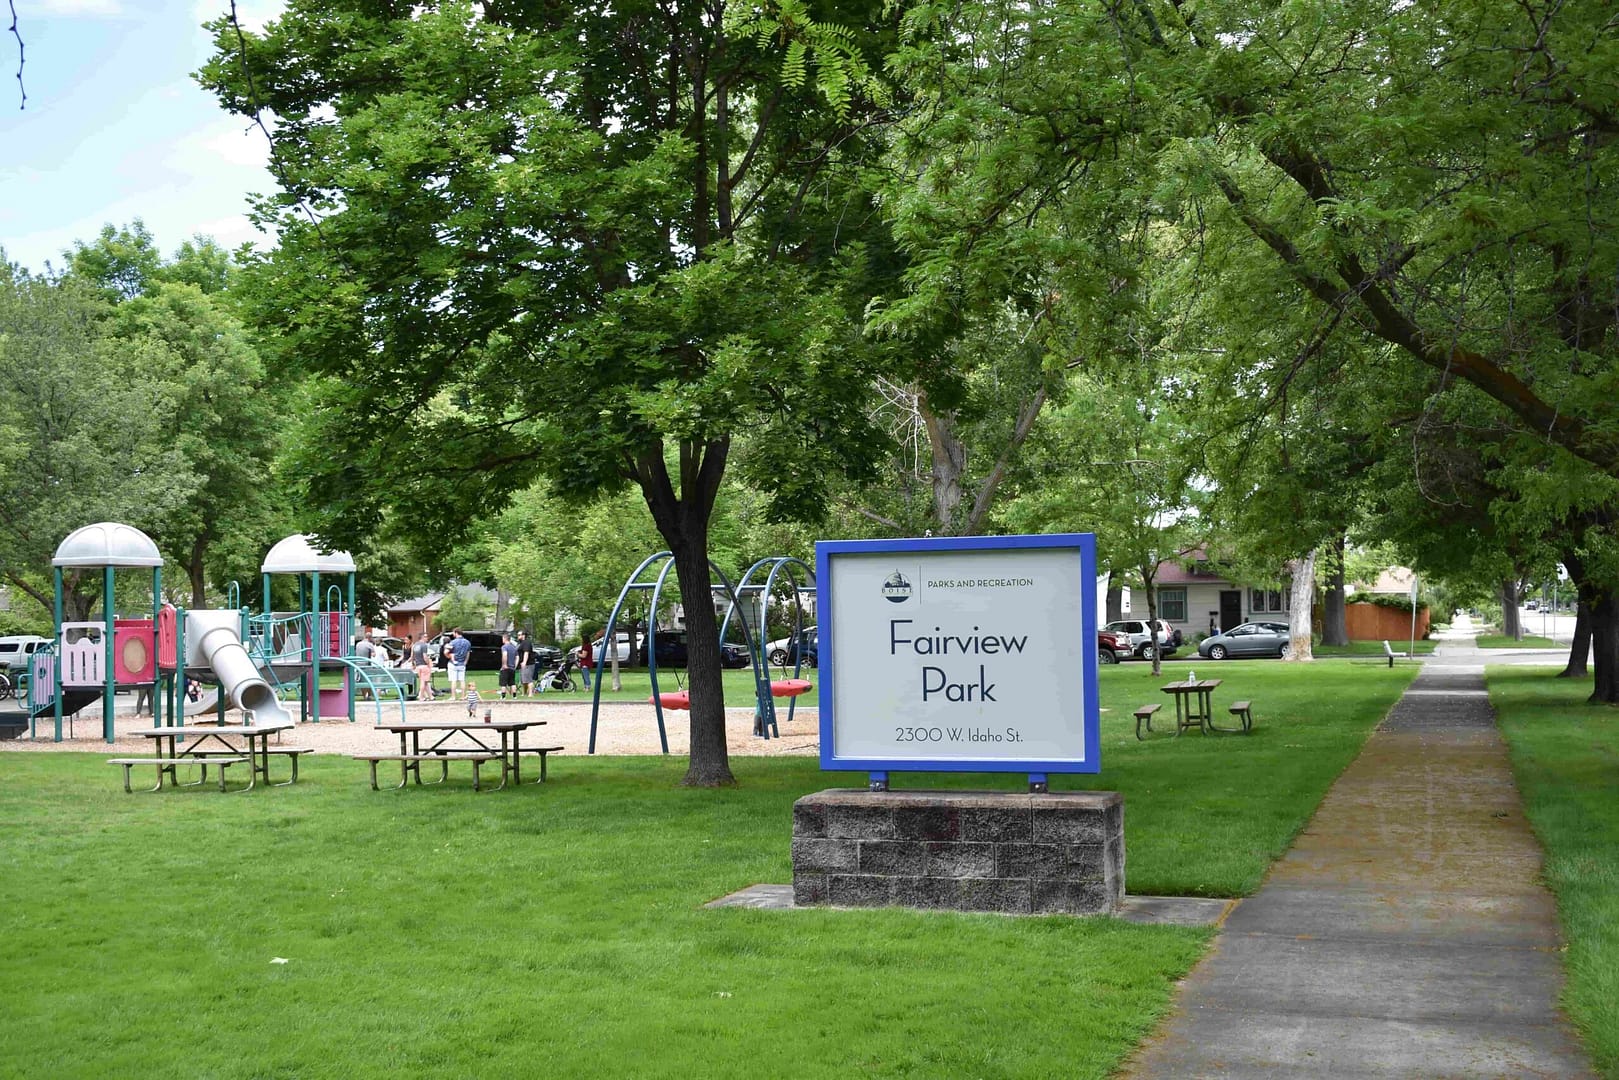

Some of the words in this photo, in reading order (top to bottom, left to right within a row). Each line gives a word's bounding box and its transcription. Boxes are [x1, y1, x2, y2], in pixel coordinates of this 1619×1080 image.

[927, 580, 955, 588] PARKS
[956, 579, 976, 588] AND
[977, 578, 1034, 588] RECREATION
[890, 619, 1028, 655] Fairview
[922, 664, 997, 703] Park
[895, 727, 943, 742] 2300
[946, 727, 965, 742] W.
[968, 727, 1003, 743] Idaho
[1006, 727, 1024, 743] St.
